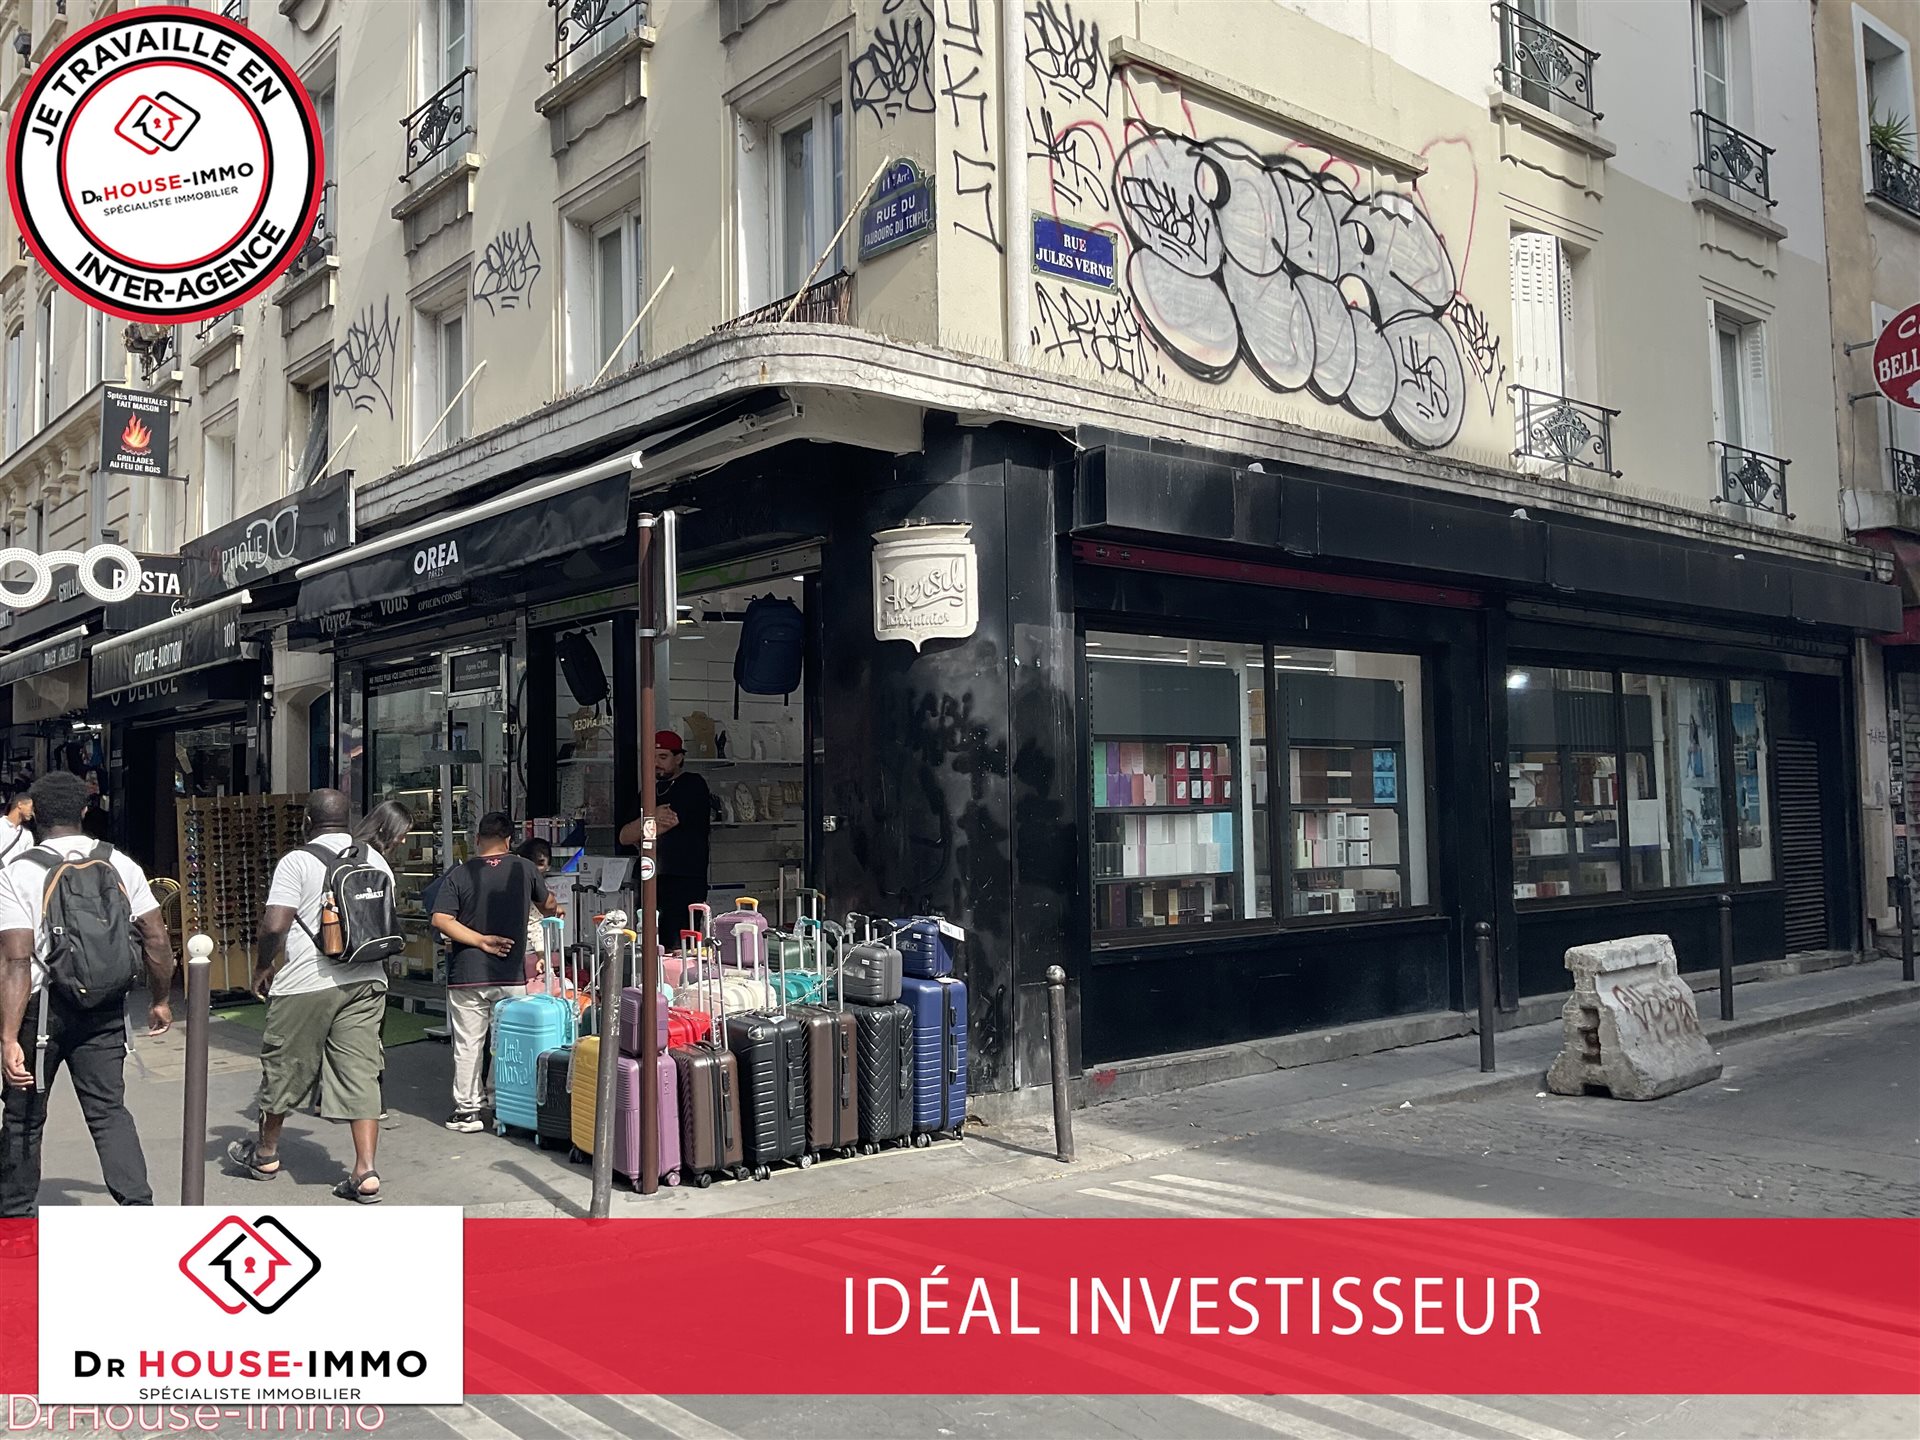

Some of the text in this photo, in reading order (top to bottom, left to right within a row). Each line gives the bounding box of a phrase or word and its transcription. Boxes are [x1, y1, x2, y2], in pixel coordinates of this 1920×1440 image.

[876, 195, 915, 224] RUE DU
[864, 208, 928, 247] FAUBOURG DU TEMPLE
[1064, 233, 1087, 252] RUE
[1035, 247, 1114, 280] JULES VERNE
[116, 400, 160, 413] FAIT MAISON
[128, 395, 168, 407] ORIENTALES
[117, 454, 154, 465] GRILLADES
[134, 464, 143, 472] DE
[144, 466, 161, 474] BOIS
[413, 540, 459, 575] OREA
[428, 567, 444, 580] PARIS
[223, 621, 236, 648] 100
